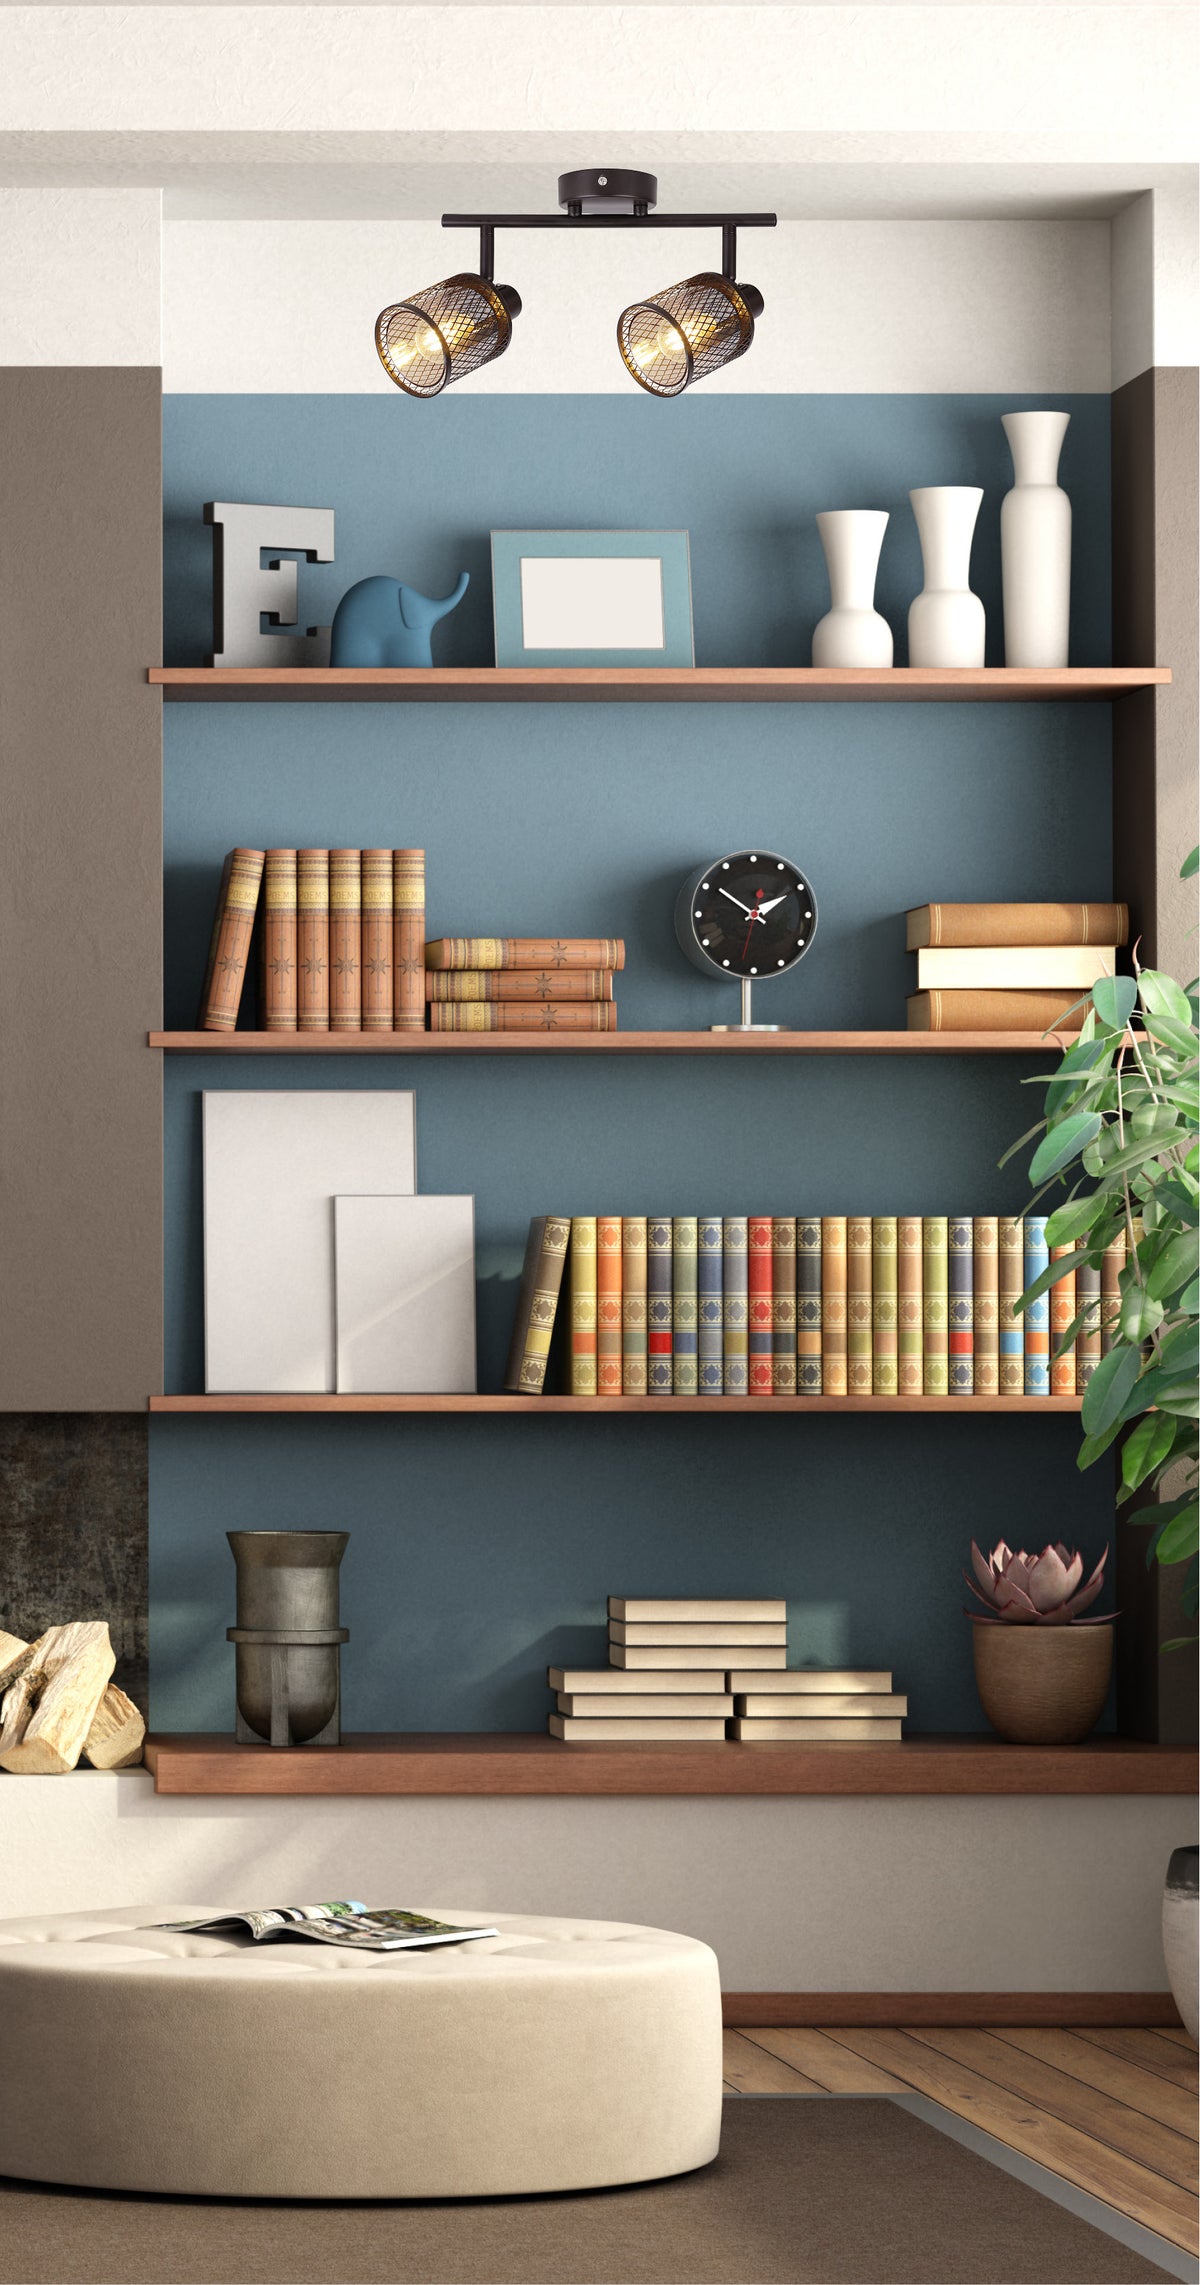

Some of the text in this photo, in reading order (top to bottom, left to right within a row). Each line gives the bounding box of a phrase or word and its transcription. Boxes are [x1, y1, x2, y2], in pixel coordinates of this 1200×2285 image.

[204, 501, 335, 668] E
[228, 888, 257, 902] POEMS
[267, 890, 296, 900] POEMS
[299, 890, 328, 900] POEMS
[332, 890, 360, 900] POEMS
[363, 890, 392, 900] POEMS
[395, 890, 424, 900] POEMS
[484, 940, 494, 968] POEMS
[468, 972, 477, 1000] POEMS
[473, 1003, 482, 1031] POEMS
